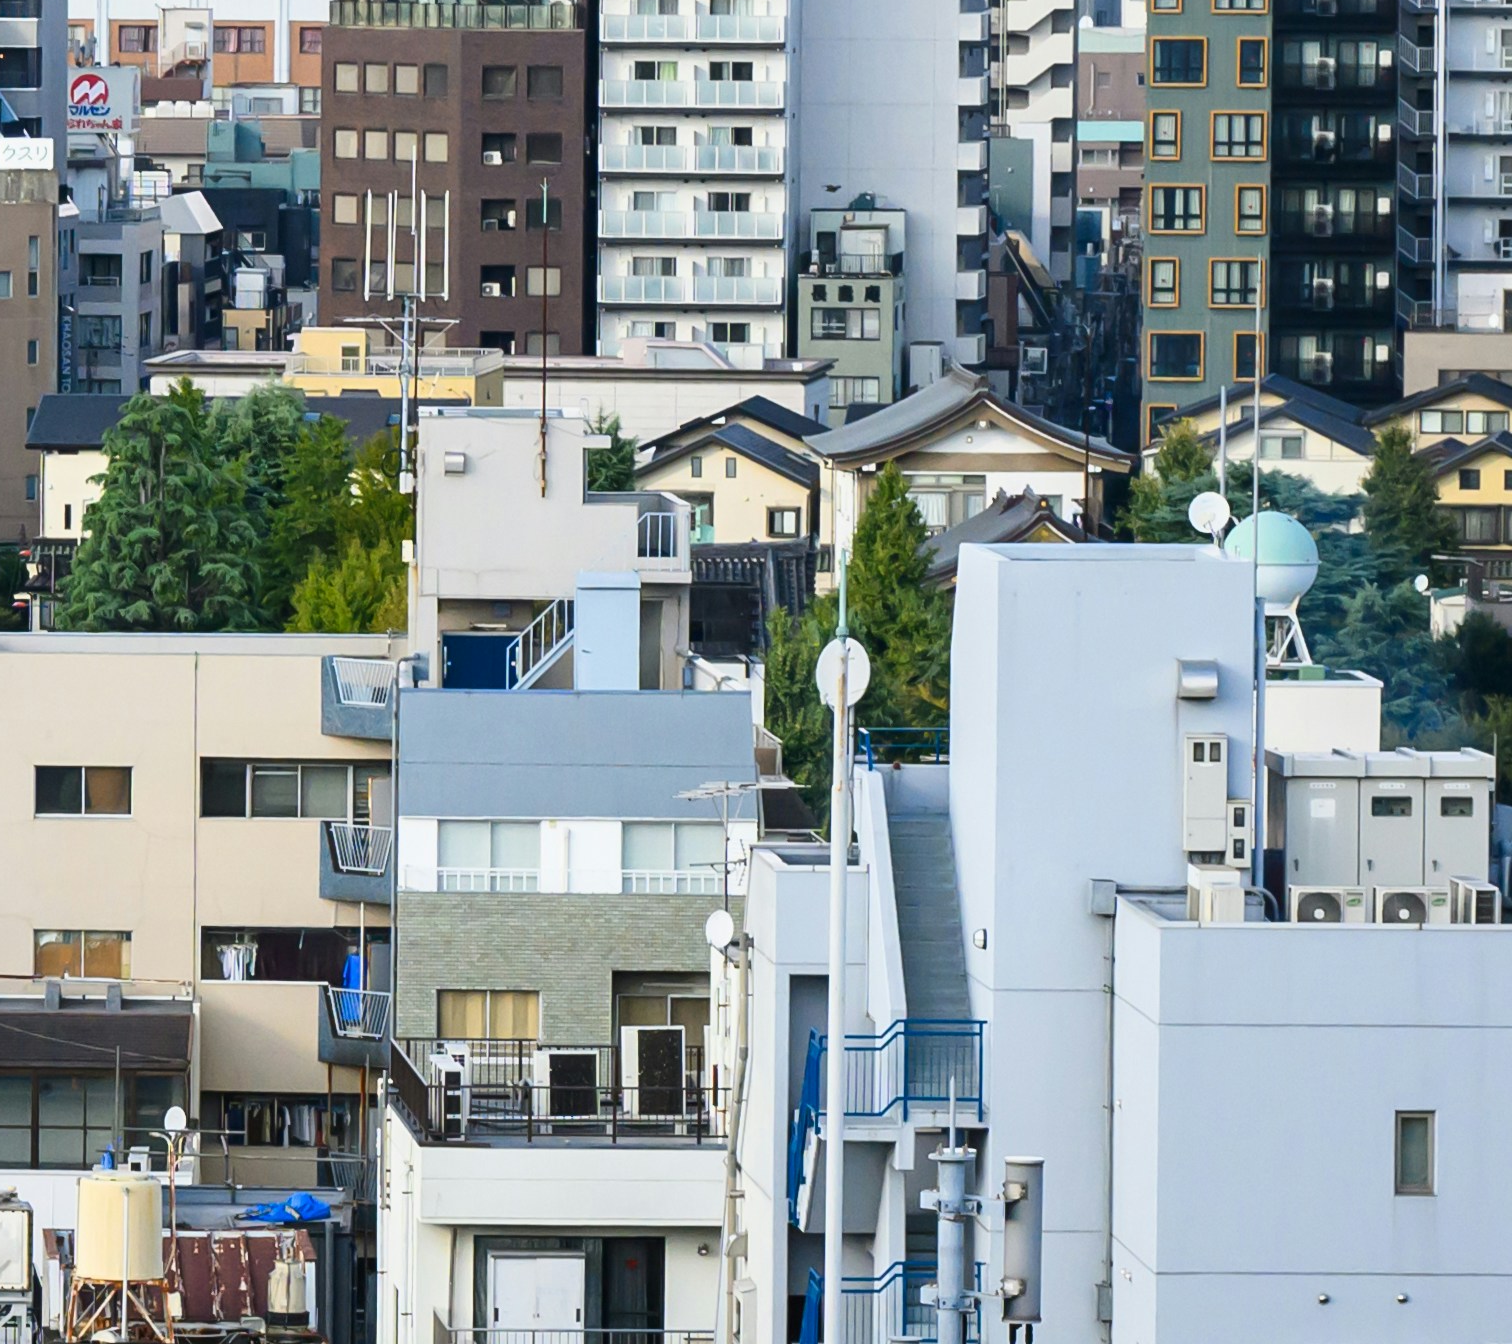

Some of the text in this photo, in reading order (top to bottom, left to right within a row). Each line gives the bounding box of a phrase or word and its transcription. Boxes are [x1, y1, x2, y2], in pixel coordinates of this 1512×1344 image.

[68, 105, 111, 116] マルセン
[2, 144, 48, 162] クスリ
[61, 316, 72, 375] KHAOSAN
